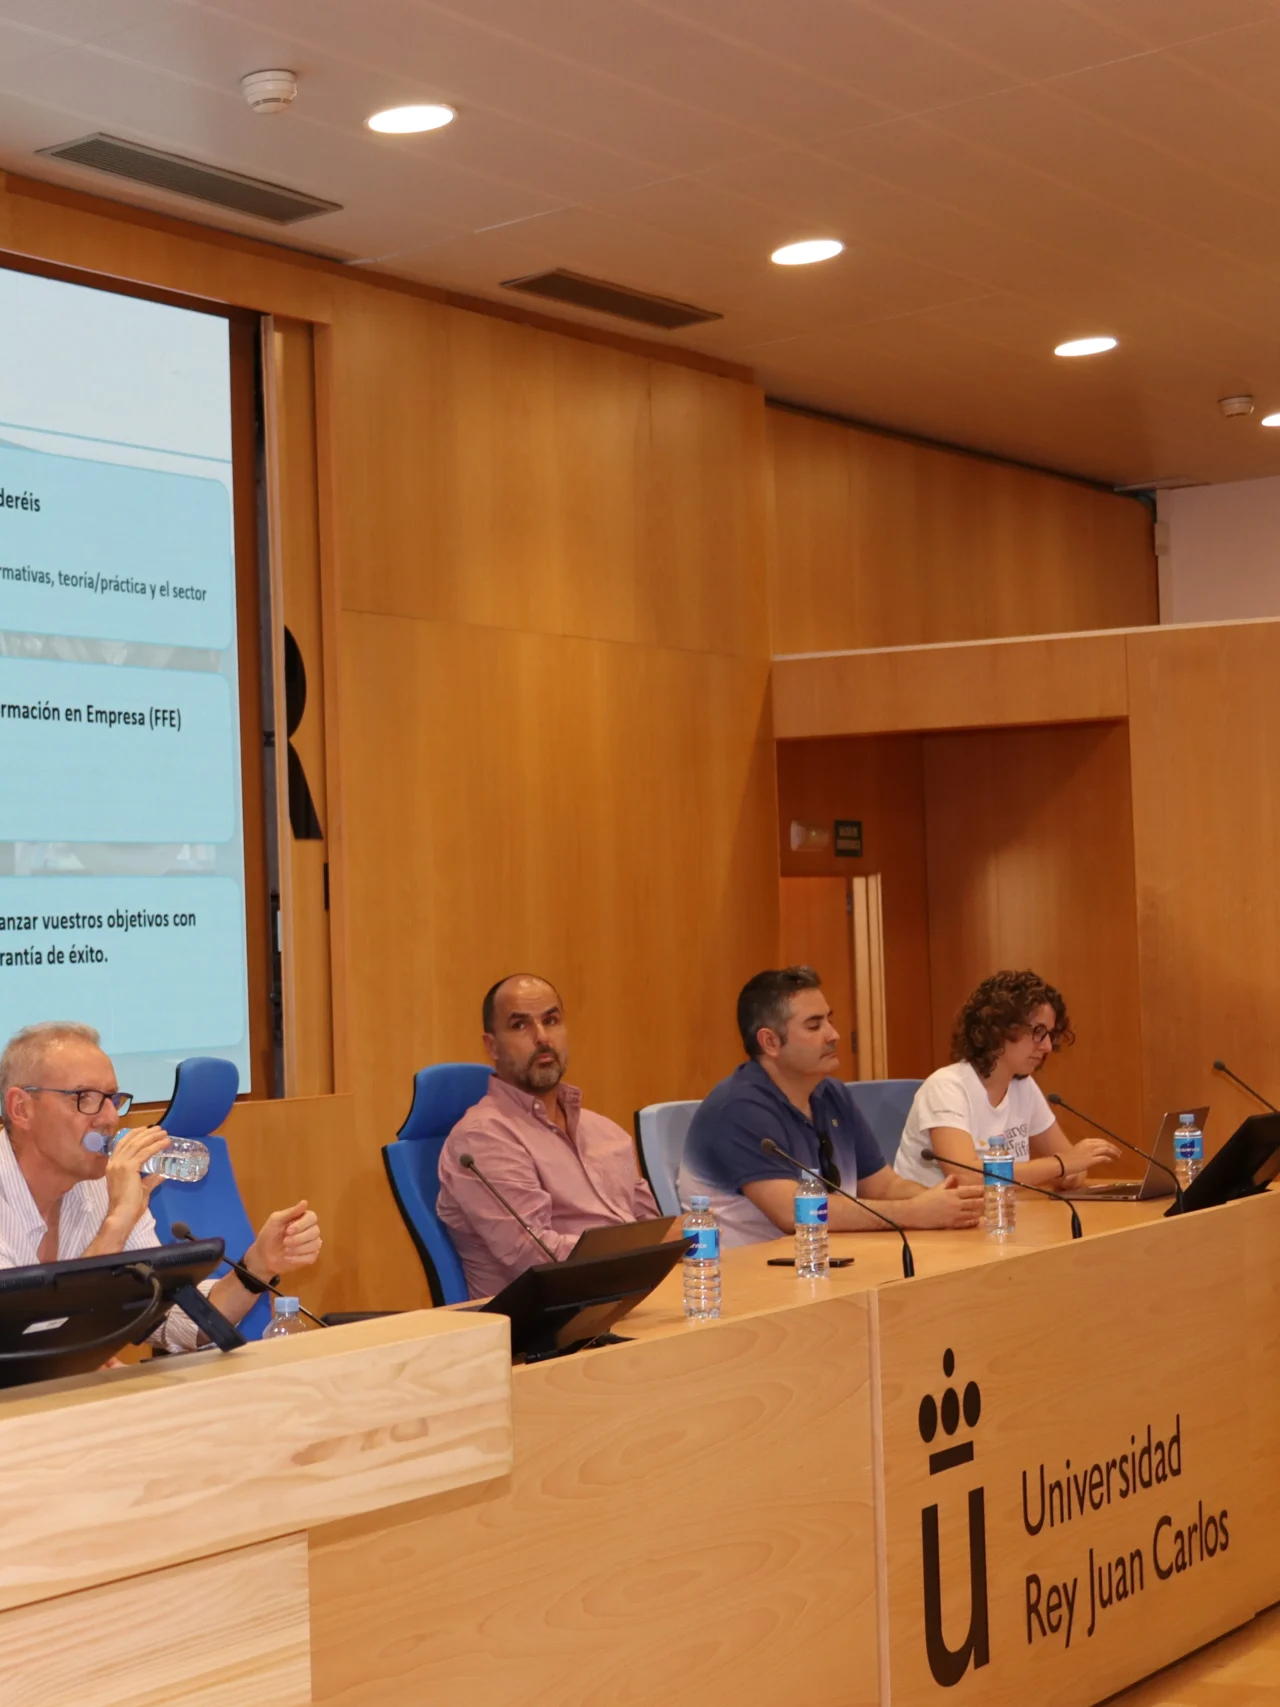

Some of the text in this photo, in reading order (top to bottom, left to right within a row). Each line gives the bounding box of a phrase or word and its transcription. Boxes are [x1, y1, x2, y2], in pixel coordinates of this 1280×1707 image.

[57, 569, 147, 595] teoría/práctica
[149, 582, 157, 600] y
[159, 579, 170, 598] el
[172, 585, 207, 602] sector
[64, 706, 83, 723] en
[86, 703, 146, 729] Empresa
[149, 705, 182, 733] (FFE)
[41, 911, 104, 931] vuestros
[106, 908, 170, 933] objetivos
[172, 912, 197, 928] con
[46, 945, 65, 966] de
[68, 944, 109, 965] éxito.
[1022, 1414, 1182, 1536] Universidad
[1025, 1500, 1230, 1649] Rey Juan Carlos
